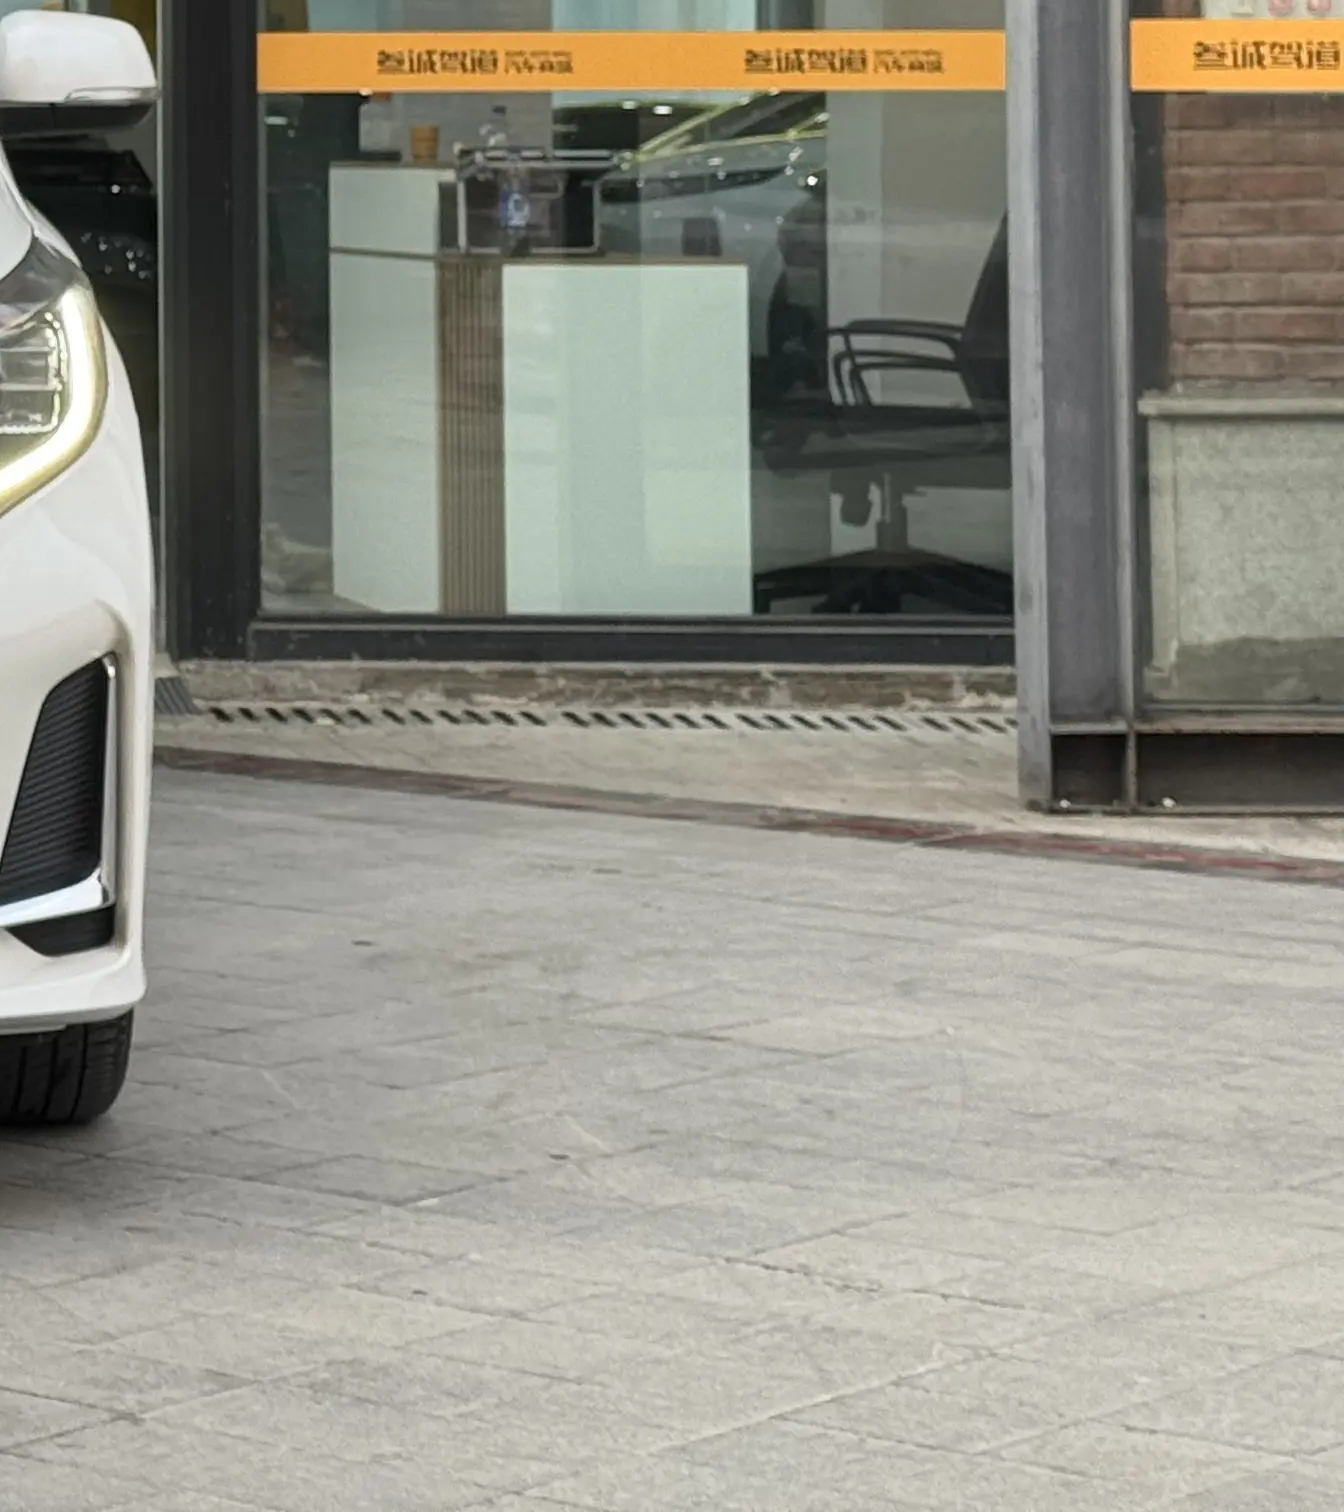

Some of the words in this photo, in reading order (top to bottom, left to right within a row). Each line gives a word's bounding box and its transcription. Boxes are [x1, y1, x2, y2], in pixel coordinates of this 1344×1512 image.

[376, 48, 499, 74] 叁诚驾道
[744, 48, 868, 74] 叁诚驾道
[1192, 39, 1342, 71] 叁诚驾道
